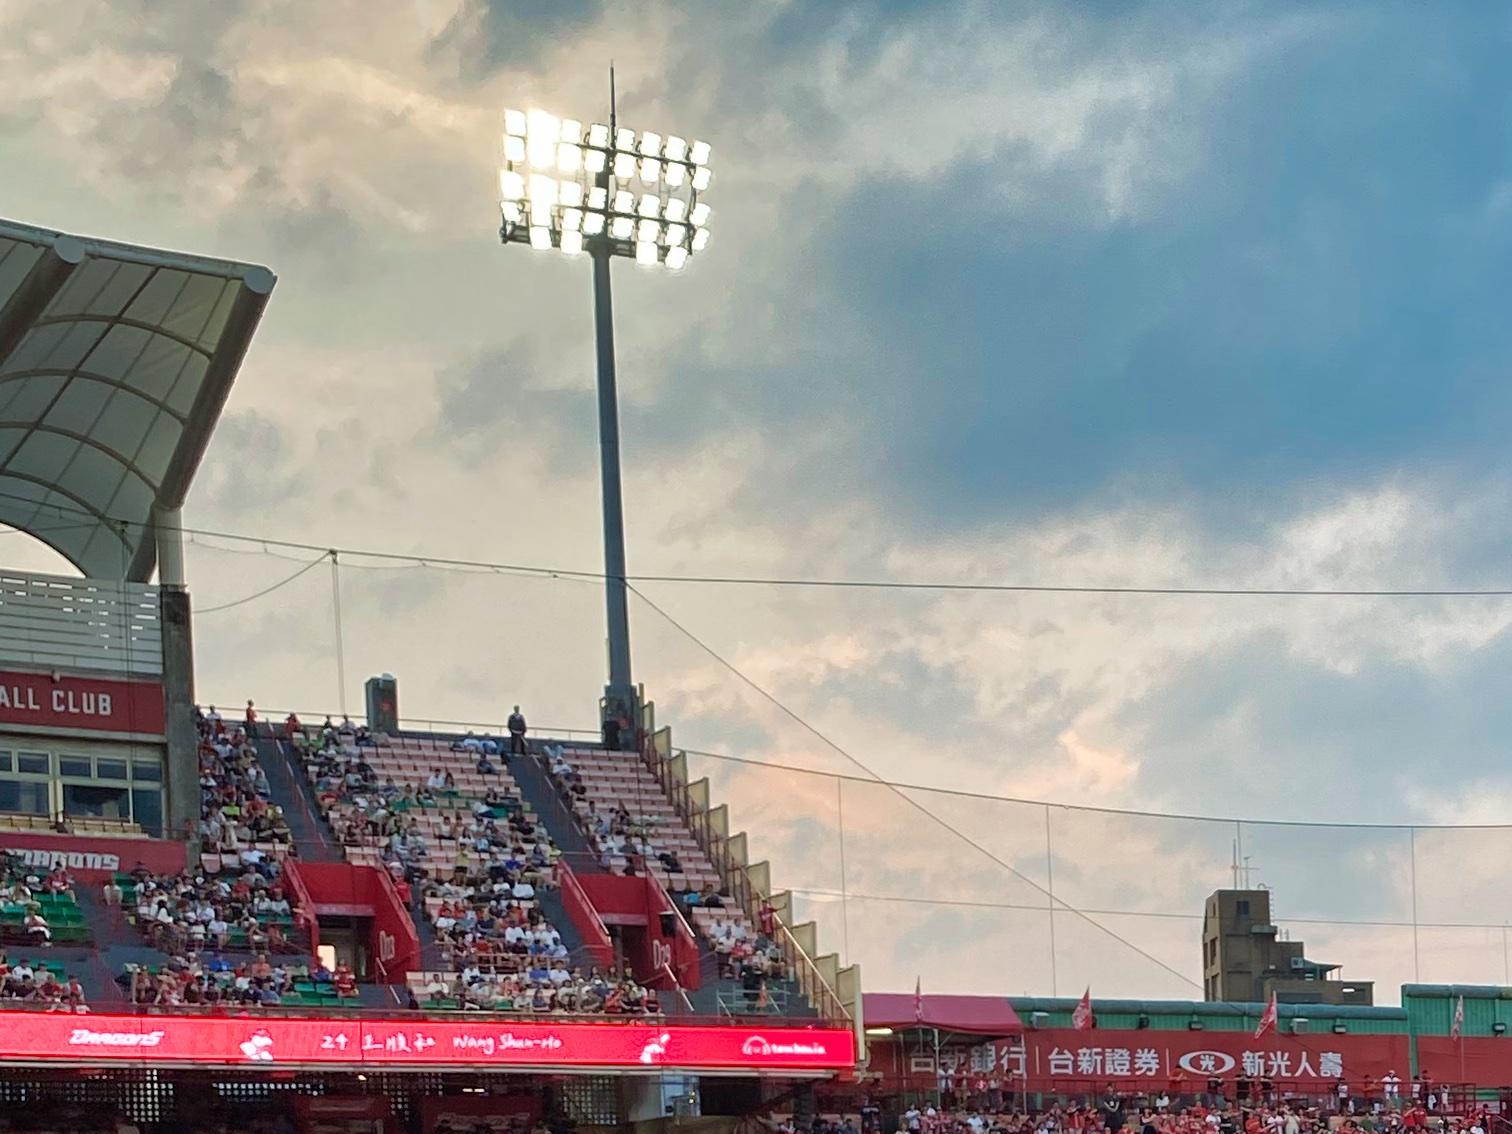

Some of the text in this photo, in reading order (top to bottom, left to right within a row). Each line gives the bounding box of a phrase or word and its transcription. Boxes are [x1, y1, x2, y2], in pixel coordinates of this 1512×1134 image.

[52, 690, 112, 715] CLUB
[320, 1033, 348, 1050] 24
[453, 1034, 494, 1055] Wang
[1048, 1048, 1160, 1077] 台新證券
[1242, 1050, 1343, 1077] 新光人壽
